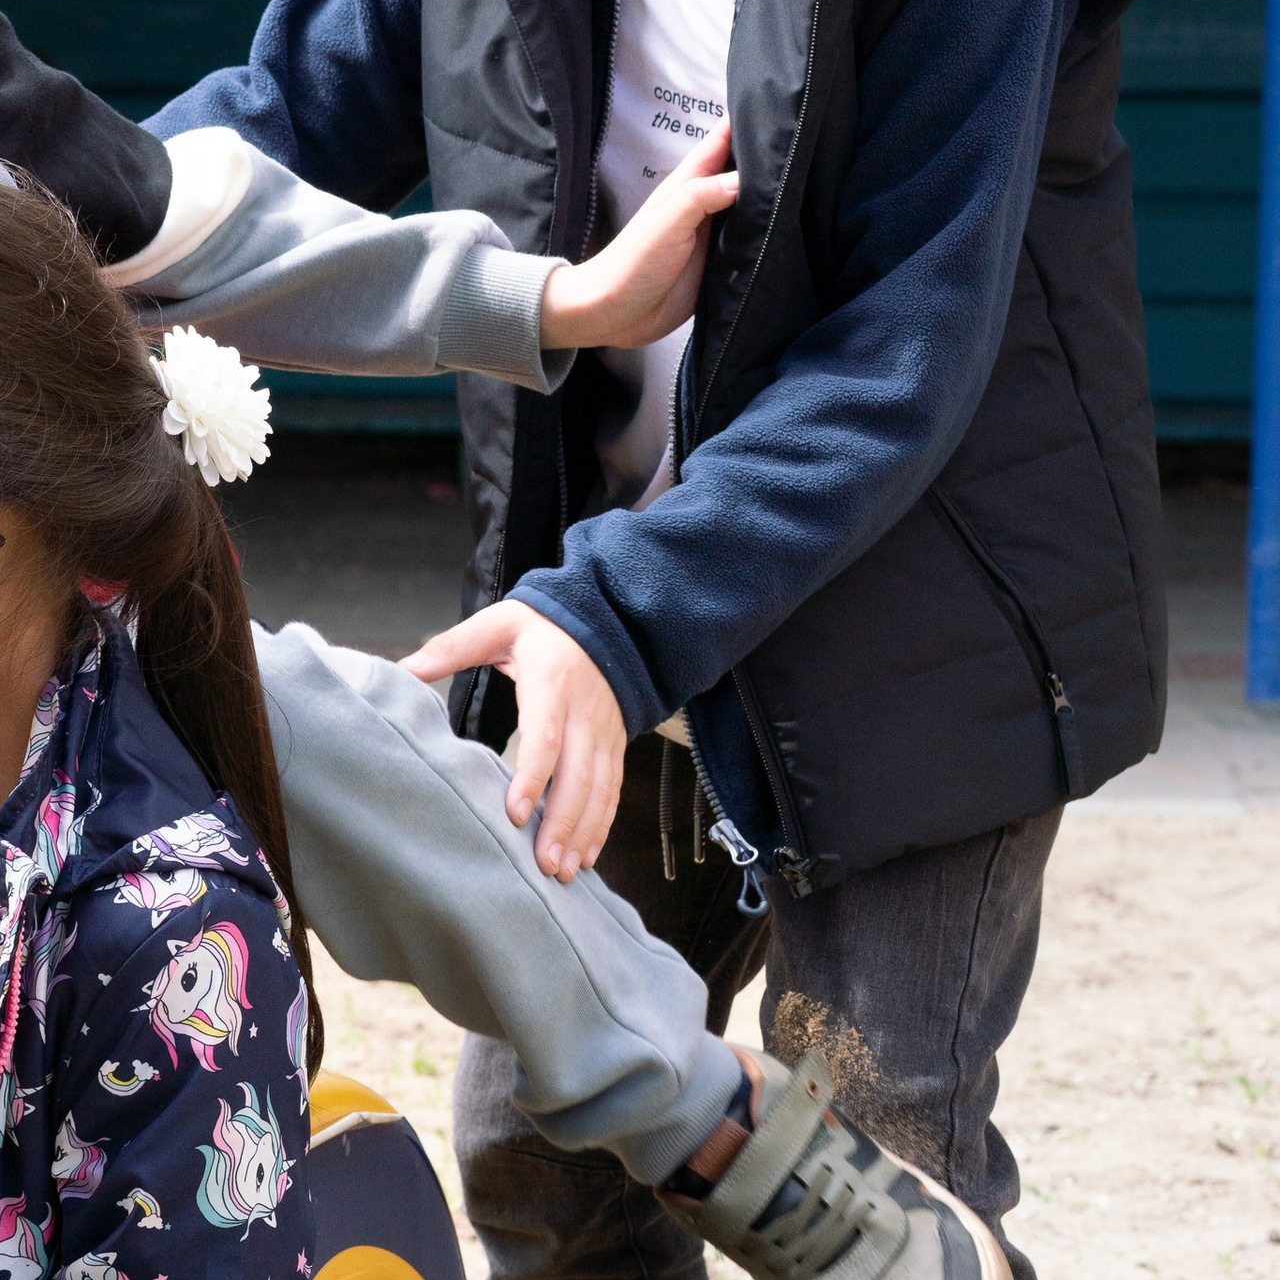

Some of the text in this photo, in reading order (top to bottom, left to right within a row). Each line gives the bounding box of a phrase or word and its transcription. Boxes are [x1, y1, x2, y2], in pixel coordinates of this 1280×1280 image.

[653, 86, 724, 118] congrats
[651, 111, 681, 133] the
[642, 166, 657, 179] for
